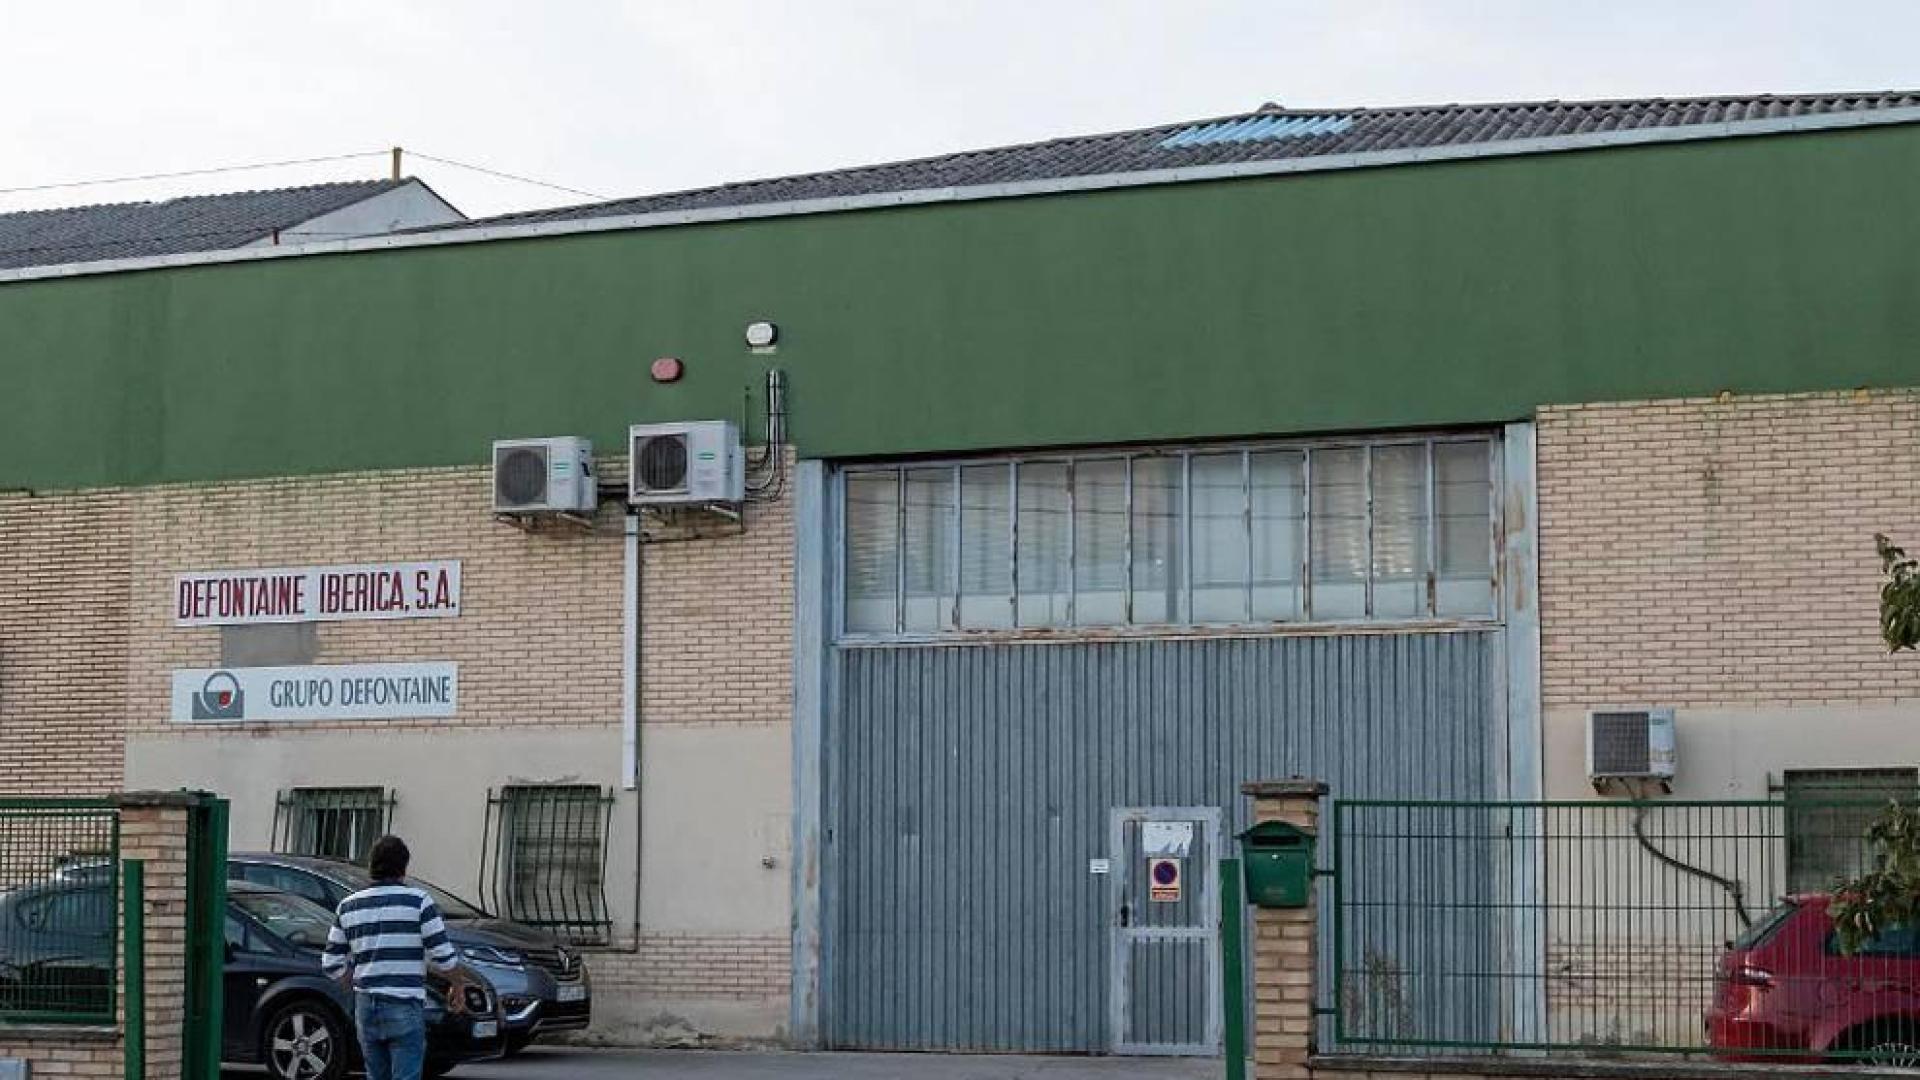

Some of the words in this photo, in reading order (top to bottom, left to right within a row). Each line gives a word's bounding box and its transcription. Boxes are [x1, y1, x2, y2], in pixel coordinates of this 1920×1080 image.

[178, 575, 306, 619] DEFONTAINE
[416, 568, 456, 609] S.A.
[270, 679, 333, 708] GRUPO
[341, 676, 451, 706] DEFONTAINE
